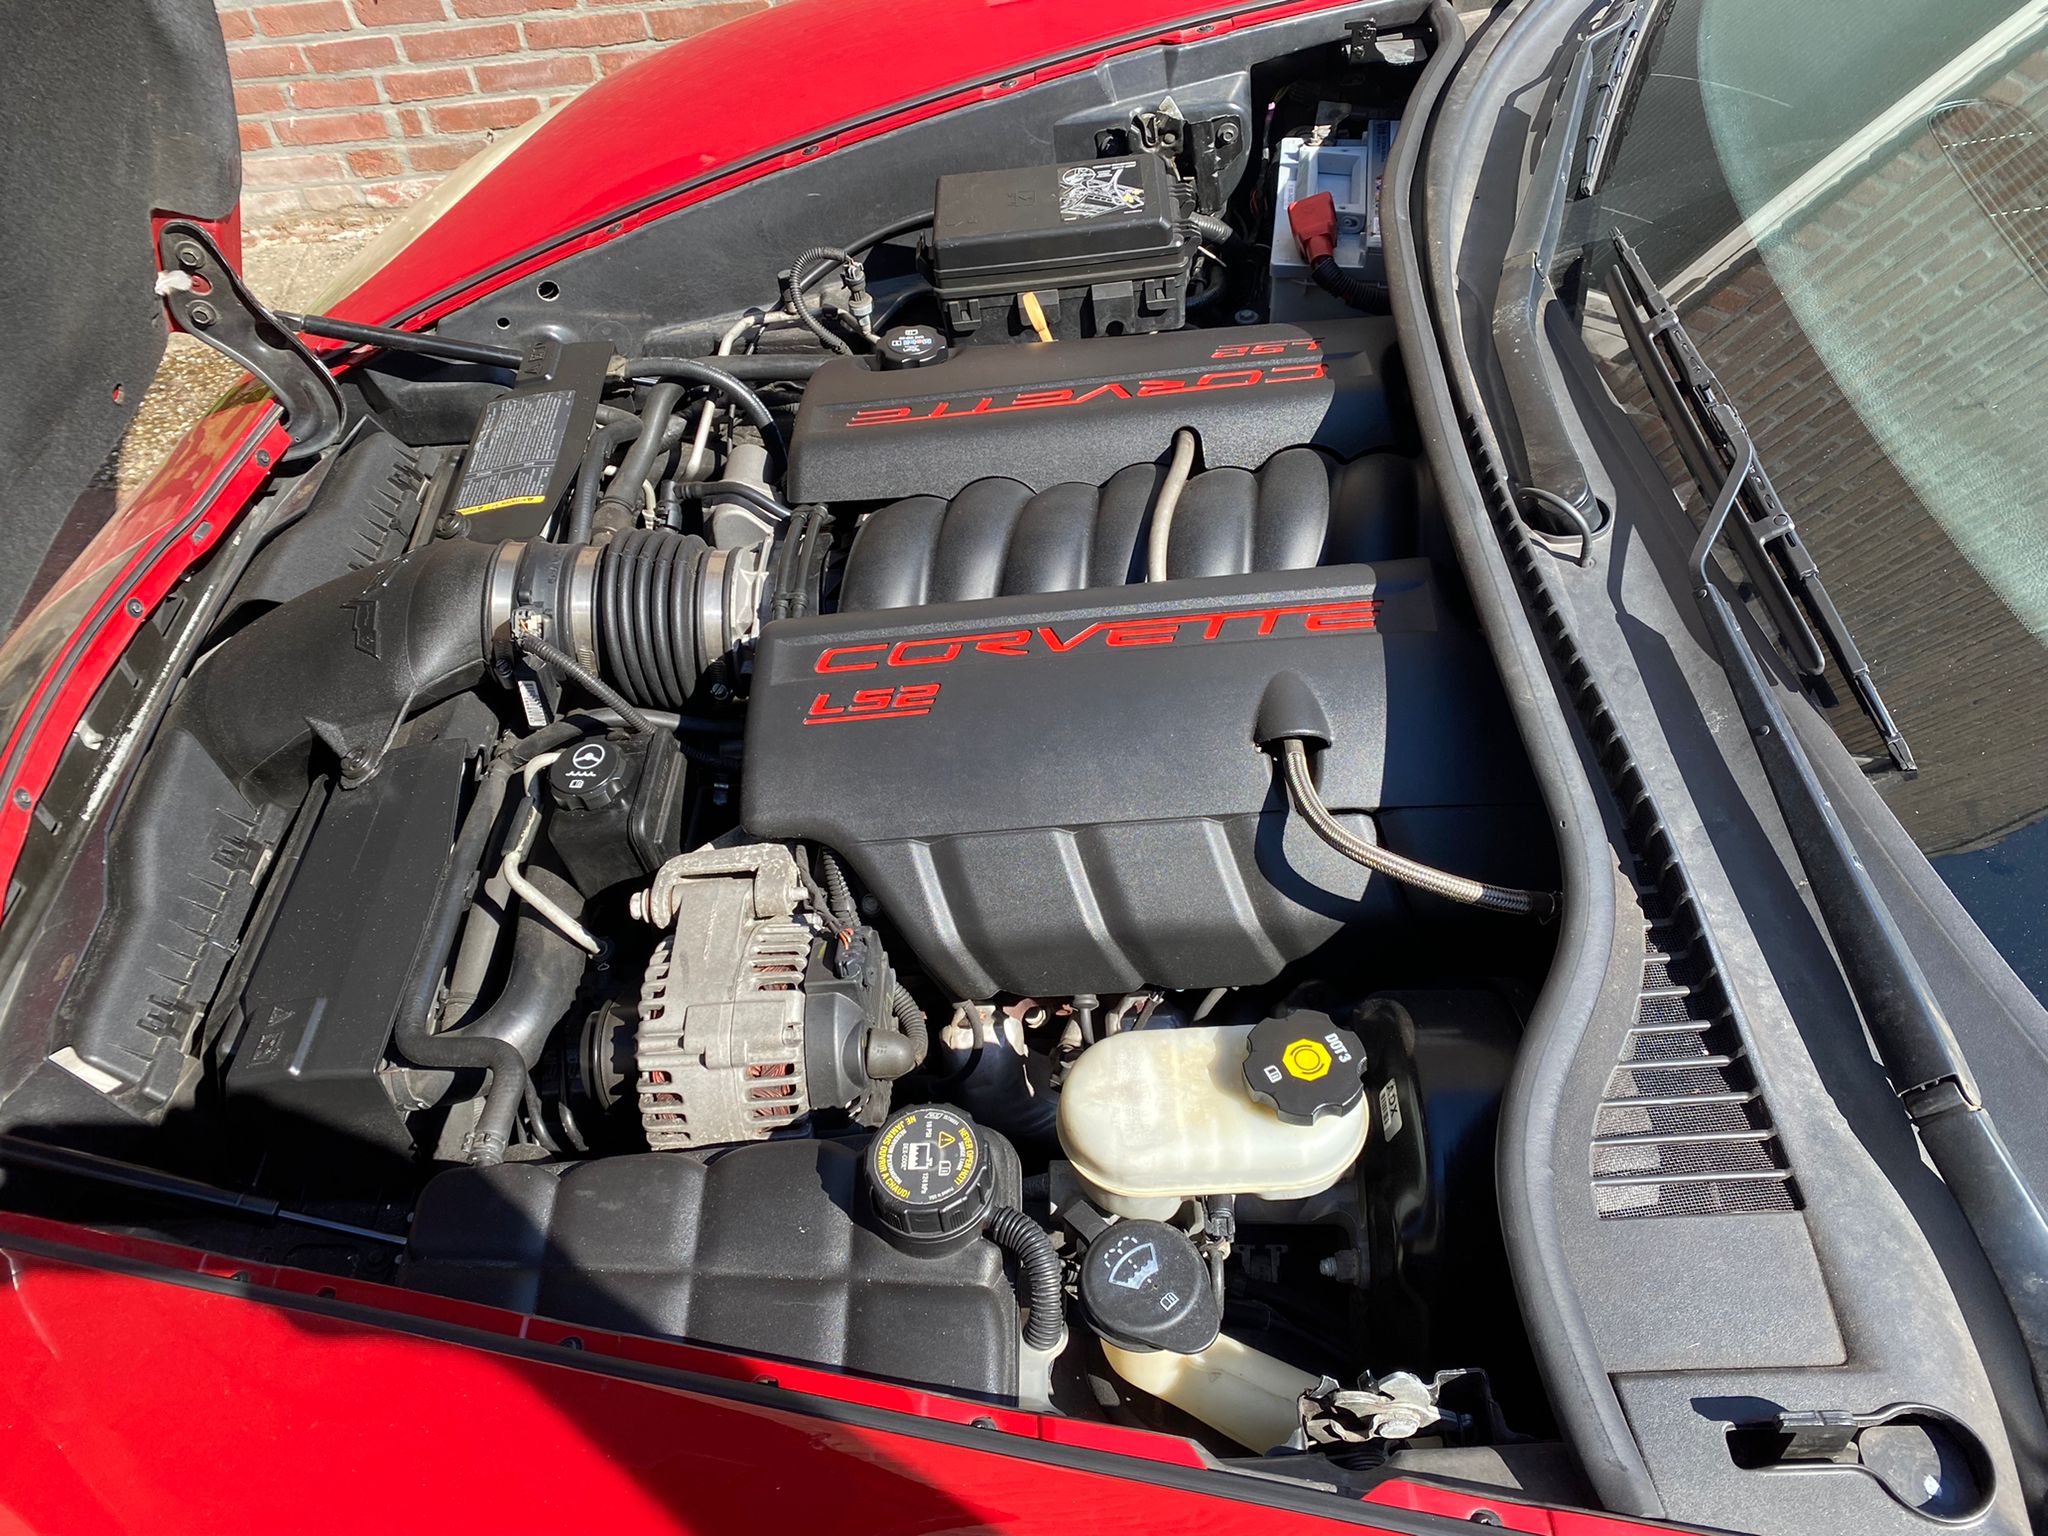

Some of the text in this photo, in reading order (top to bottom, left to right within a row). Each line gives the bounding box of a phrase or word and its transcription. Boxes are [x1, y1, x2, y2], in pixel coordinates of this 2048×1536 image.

[1210, 337, 1323, 359] LS2
[845, 362, 1329, 427] CORVETTE
[813, 600, 1384, 675] CORVETTE
[803, 682, 942, 722] LS2
[1386, 1084, 1398, 1117] ADX
[882, 1121, 905, 1146] JAMAIS
[905, 1115, 917, 1126] NE
[958, 1127, 973, 1151] NEVER
[878, 1145, 888, 1173] OUVRIR
[965, 1149, 974, 1172] OPEN
